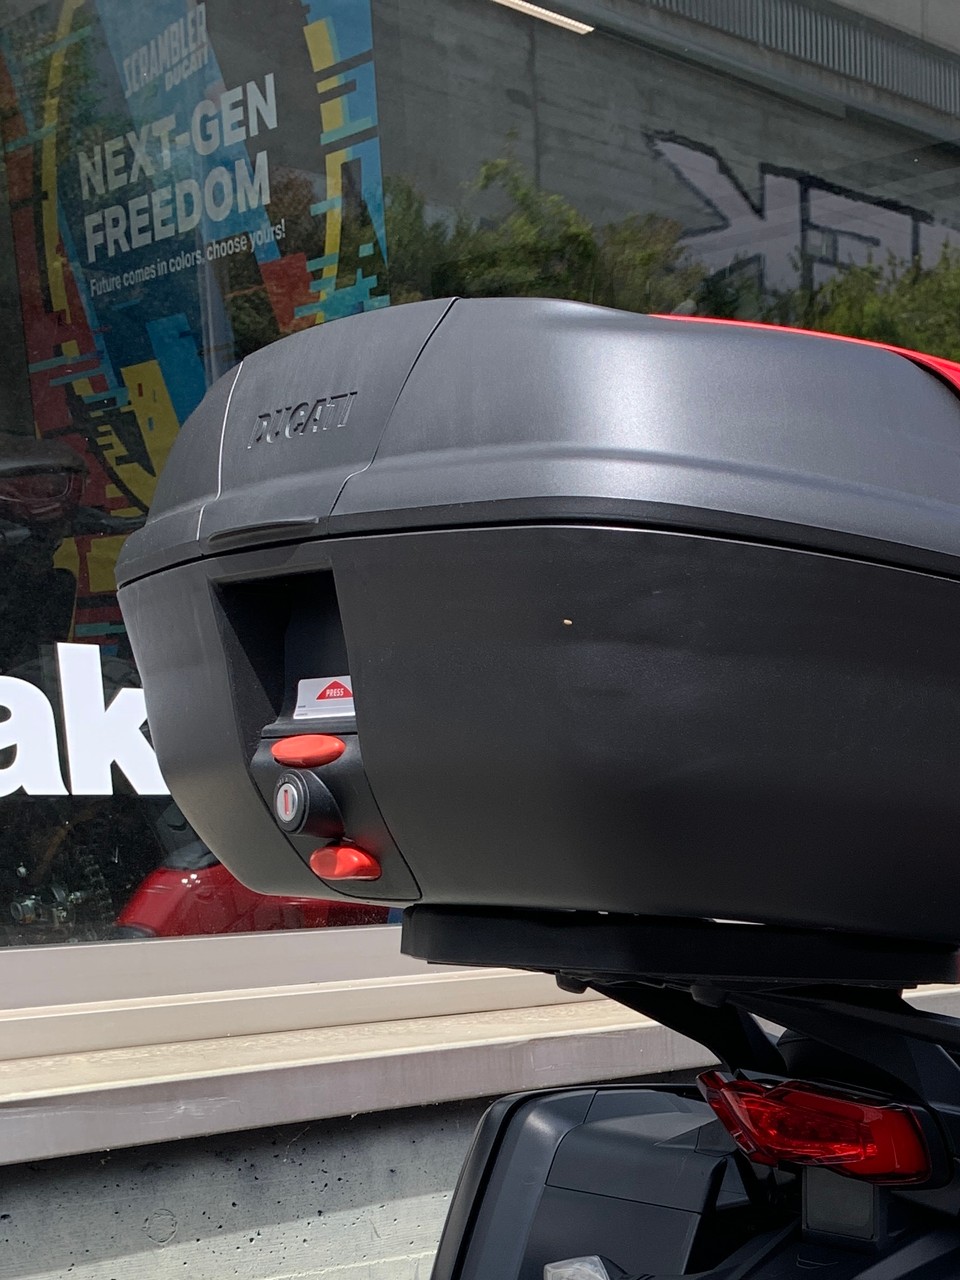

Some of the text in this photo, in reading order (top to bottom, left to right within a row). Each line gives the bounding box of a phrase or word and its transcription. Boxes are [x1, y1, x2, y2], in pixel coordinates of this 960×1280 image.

[123, 3, 208, 99] SCRAMBLER
[77, 73, 278, 199] NEXT-GEN
[84, 150, 271, 264] FREEDOM
[90, 272, 122, 298] Future
[122, 262, 157, 287] comes
[157, 257, 168, 275] in
[206, 233, 248, 261] choose
[249, 218, 286, 252] yours!
[247, 391, 358, 449] DUCATI
[326, 688, 344, 697] PRESS
